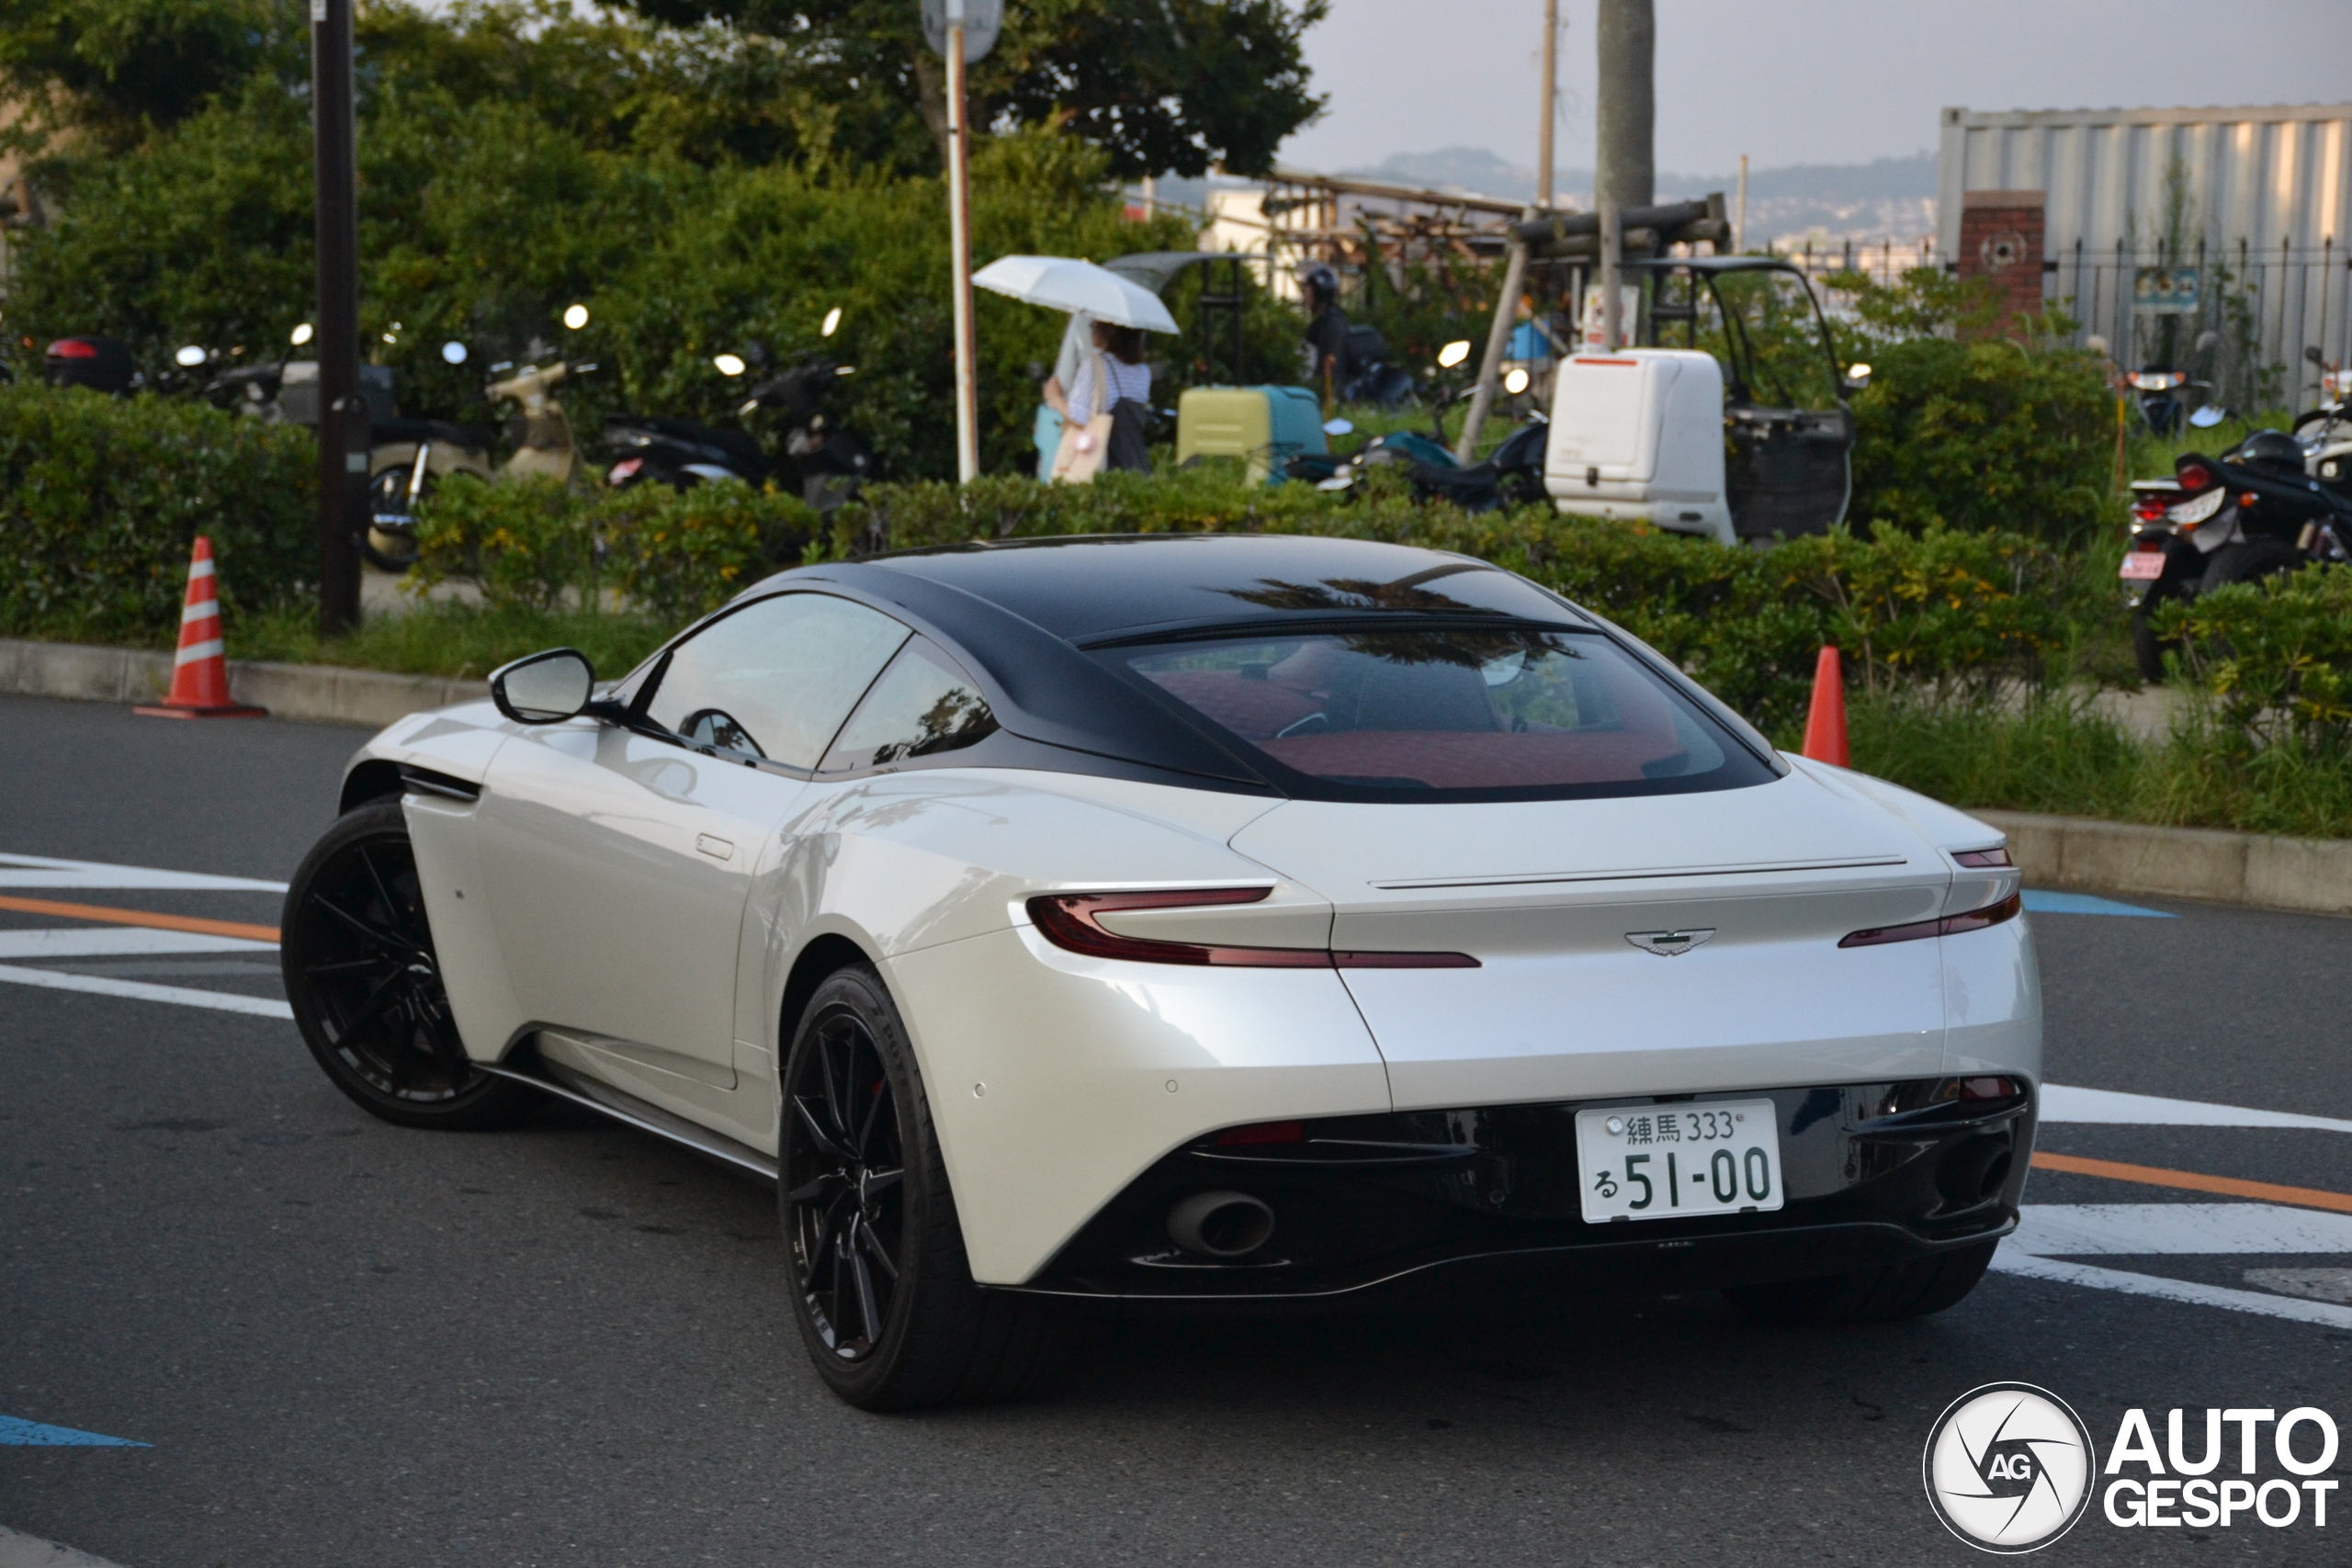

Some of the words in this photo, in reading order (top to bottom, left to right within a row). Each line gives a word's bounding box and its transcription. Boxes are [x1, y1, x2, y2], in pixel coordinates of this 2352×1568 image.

[1626, 1113, 1680, 1145] 練馬
[1686, 1111, 1735, 1142] 333
[1594, 1170, 1618, 1198] る
[1624, 1146, 1771, 1210] 51-00
